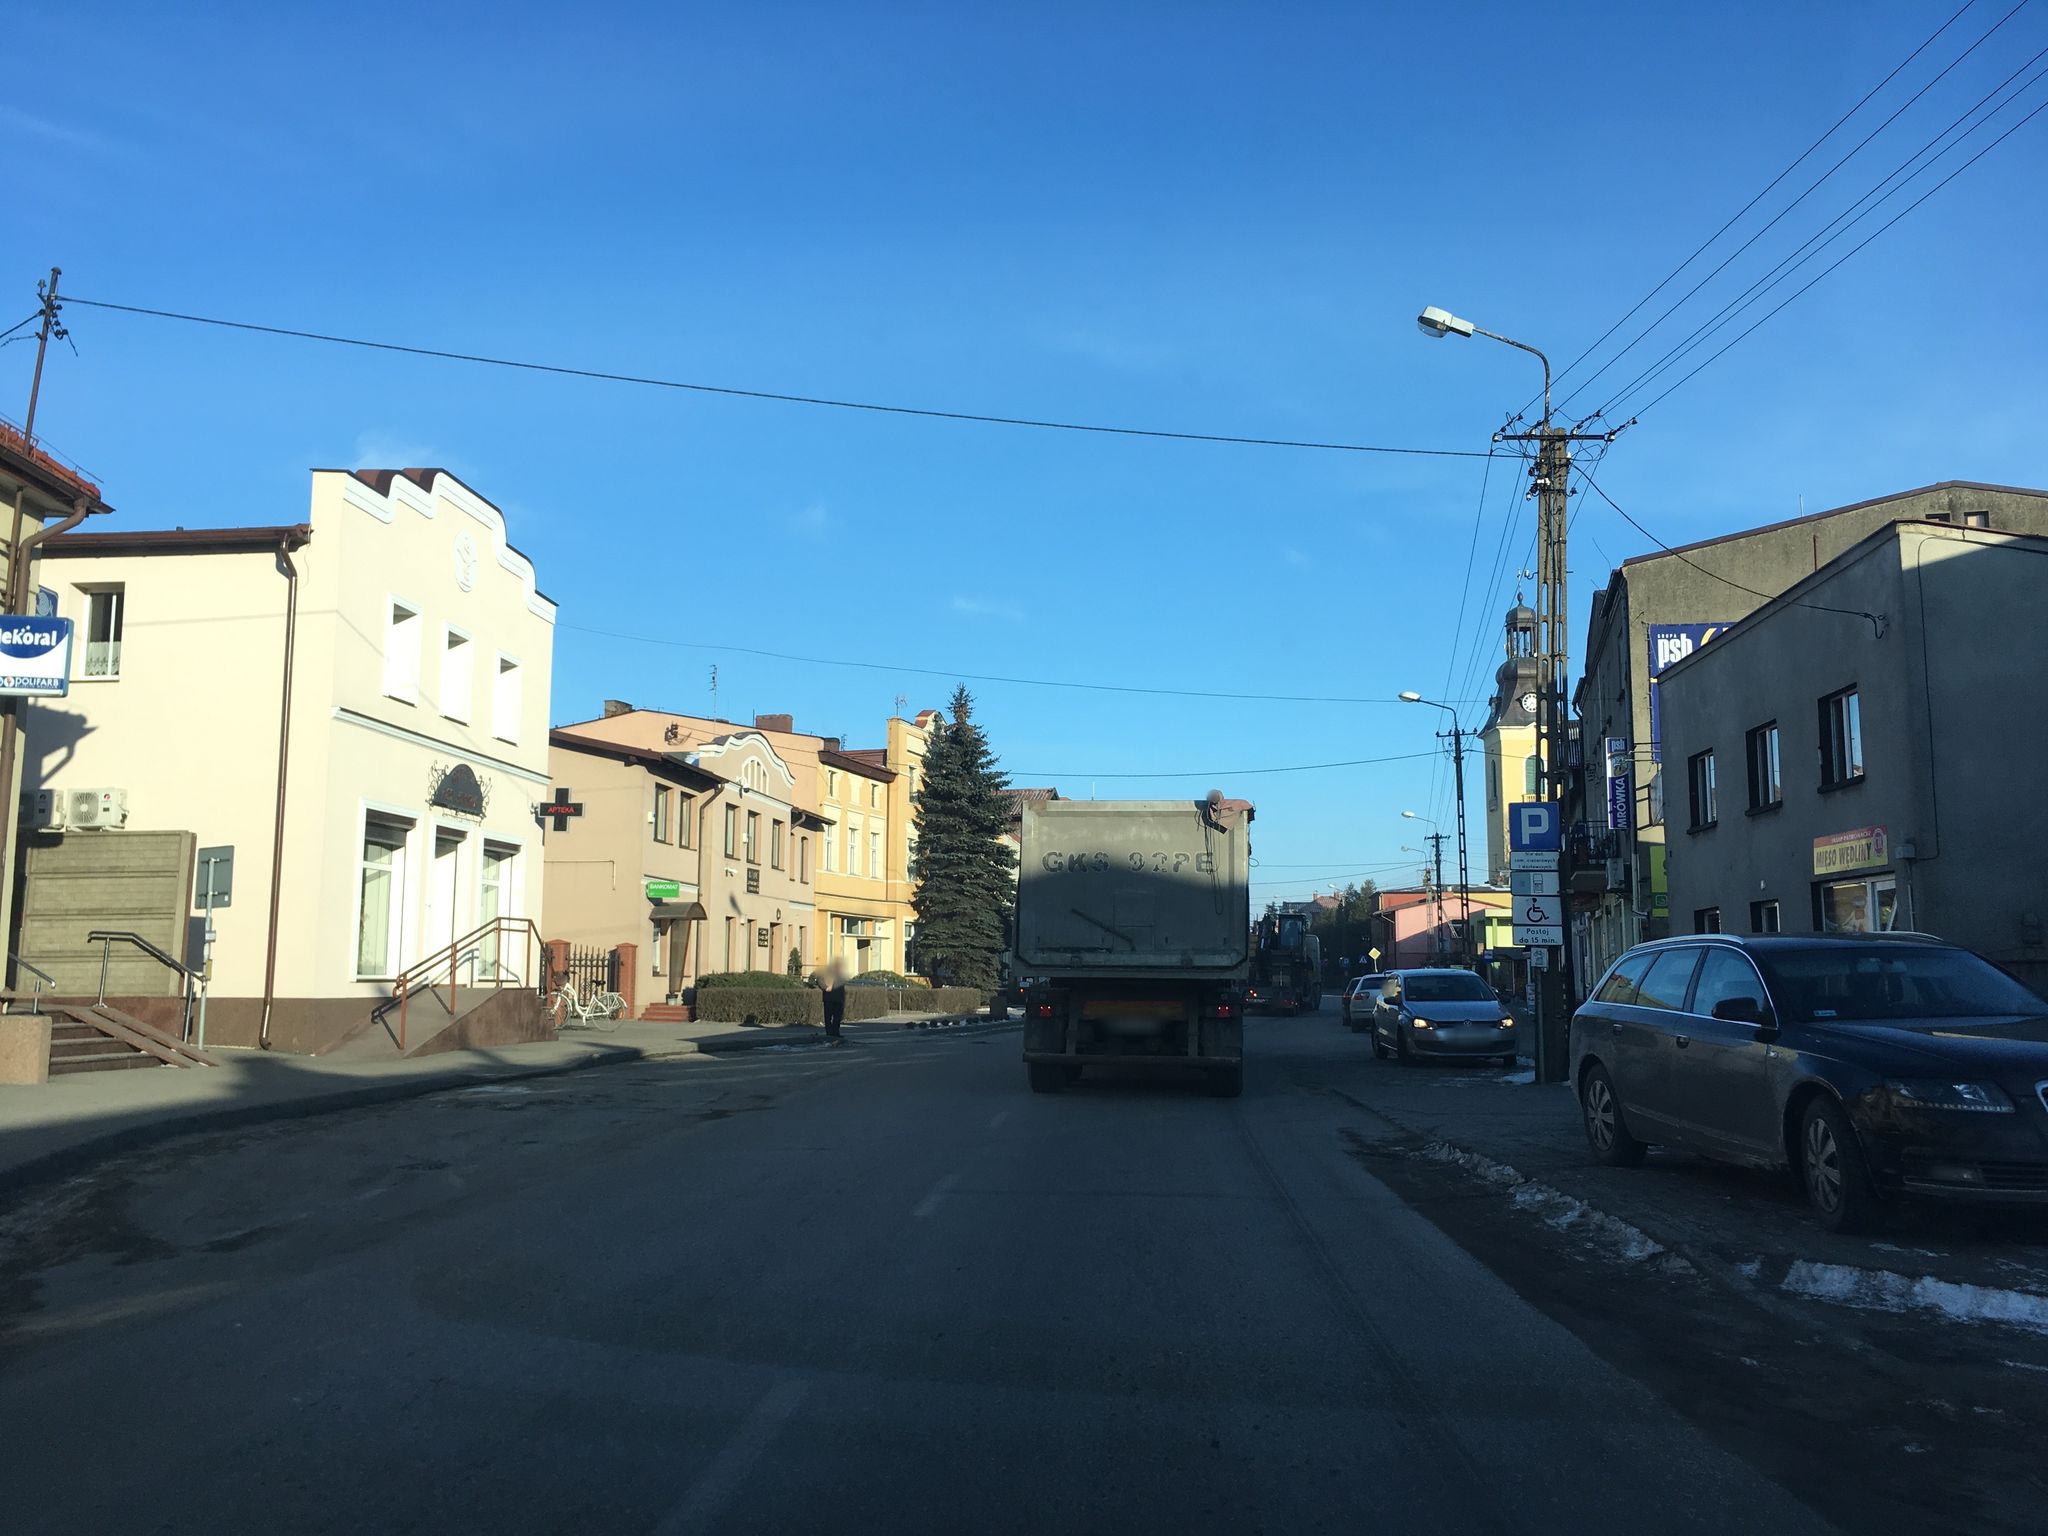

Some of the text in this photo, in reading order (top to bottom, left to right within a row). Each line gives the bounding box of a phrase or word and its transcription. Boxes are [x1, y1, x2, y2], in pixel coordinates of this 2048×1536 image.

[0, 625, 57, 646] ekoral
[1657, 633, 1693, 668] psb
[15, 677, 59, 687] POLIFARB
[1613, 777, 1626, 828] MRÓWKA
[1521, 807, 1549, 845] P
[1816, 849, 1837, 872] MIĘSO
[1839, 842, 1872, 867] WĘDLINY
